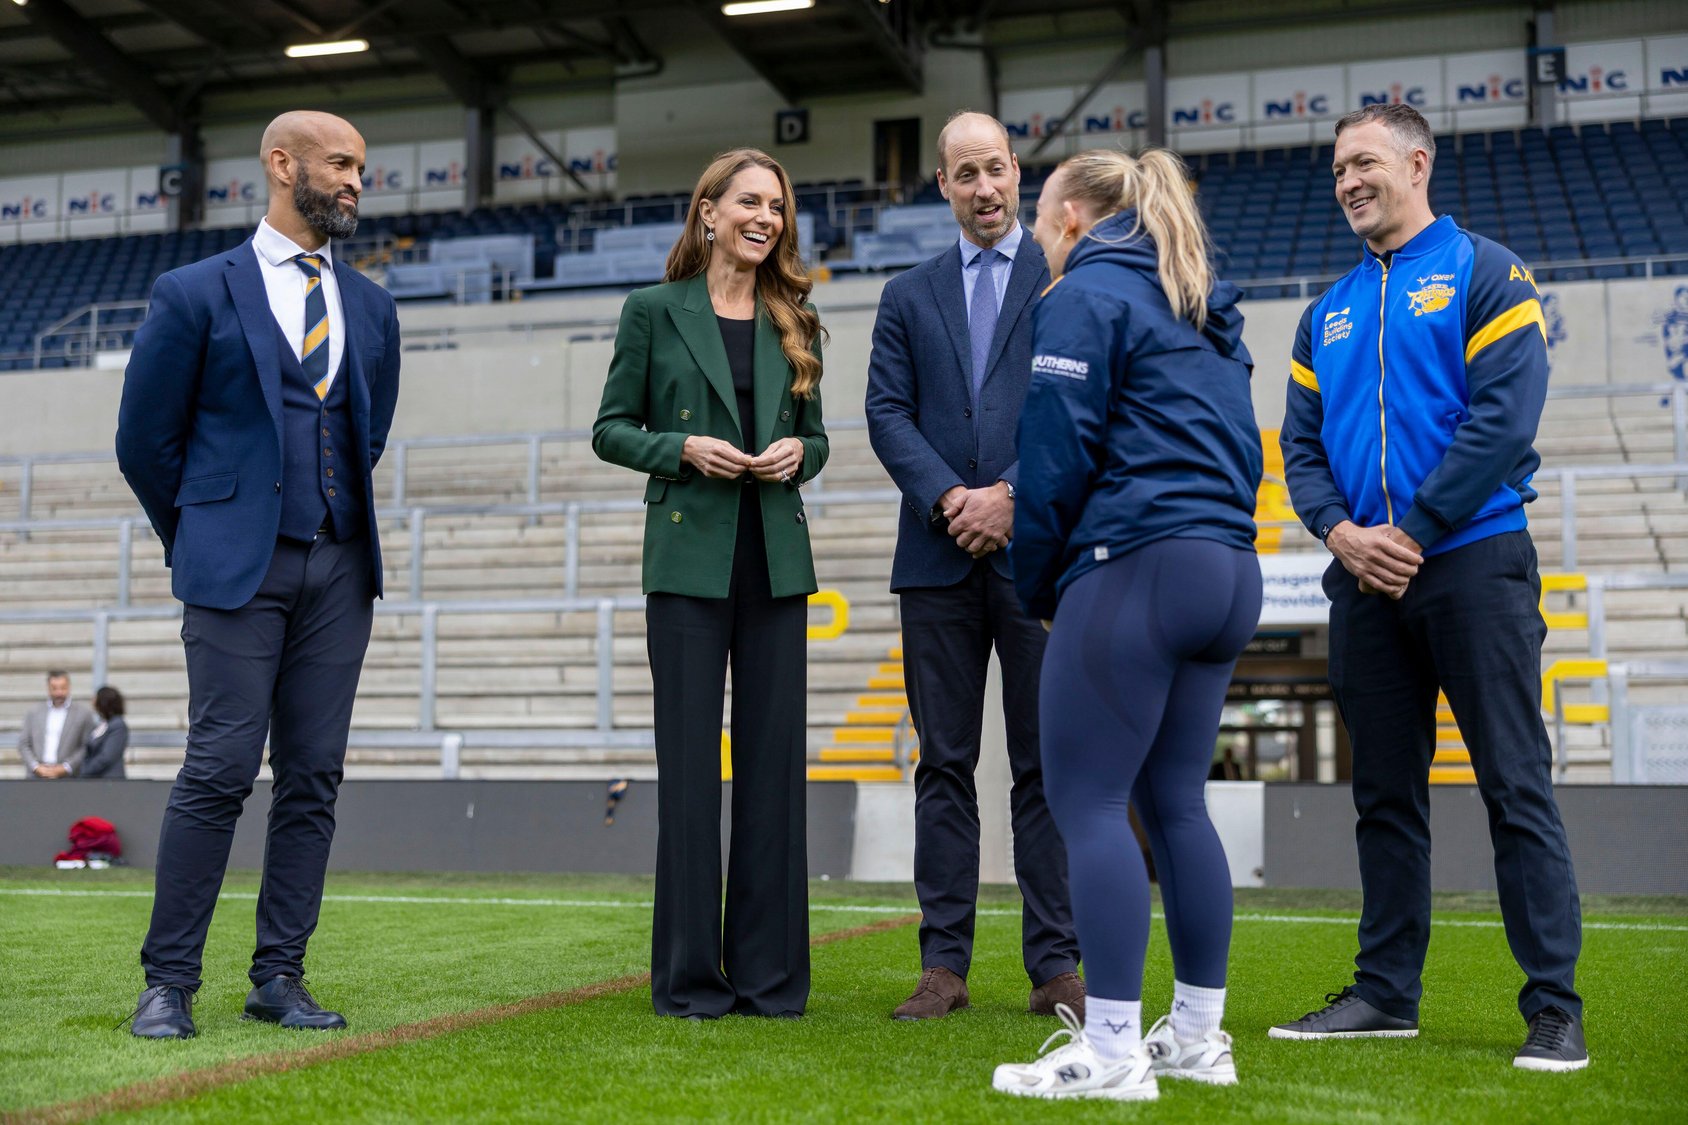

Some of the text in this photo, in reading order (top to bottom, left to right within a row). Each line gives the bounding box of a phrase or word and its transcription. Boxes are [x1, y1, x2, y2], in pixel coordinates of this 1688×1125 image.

[1537, 54, 1557, 82] E
[781, 116, 802, 140] D
[162, 171, 182, 195] C
[1324, 322, 1352, 338] Building
[1325, 317, 1347, 330] Leeds
[1323, 330, 1351, 346] Society
